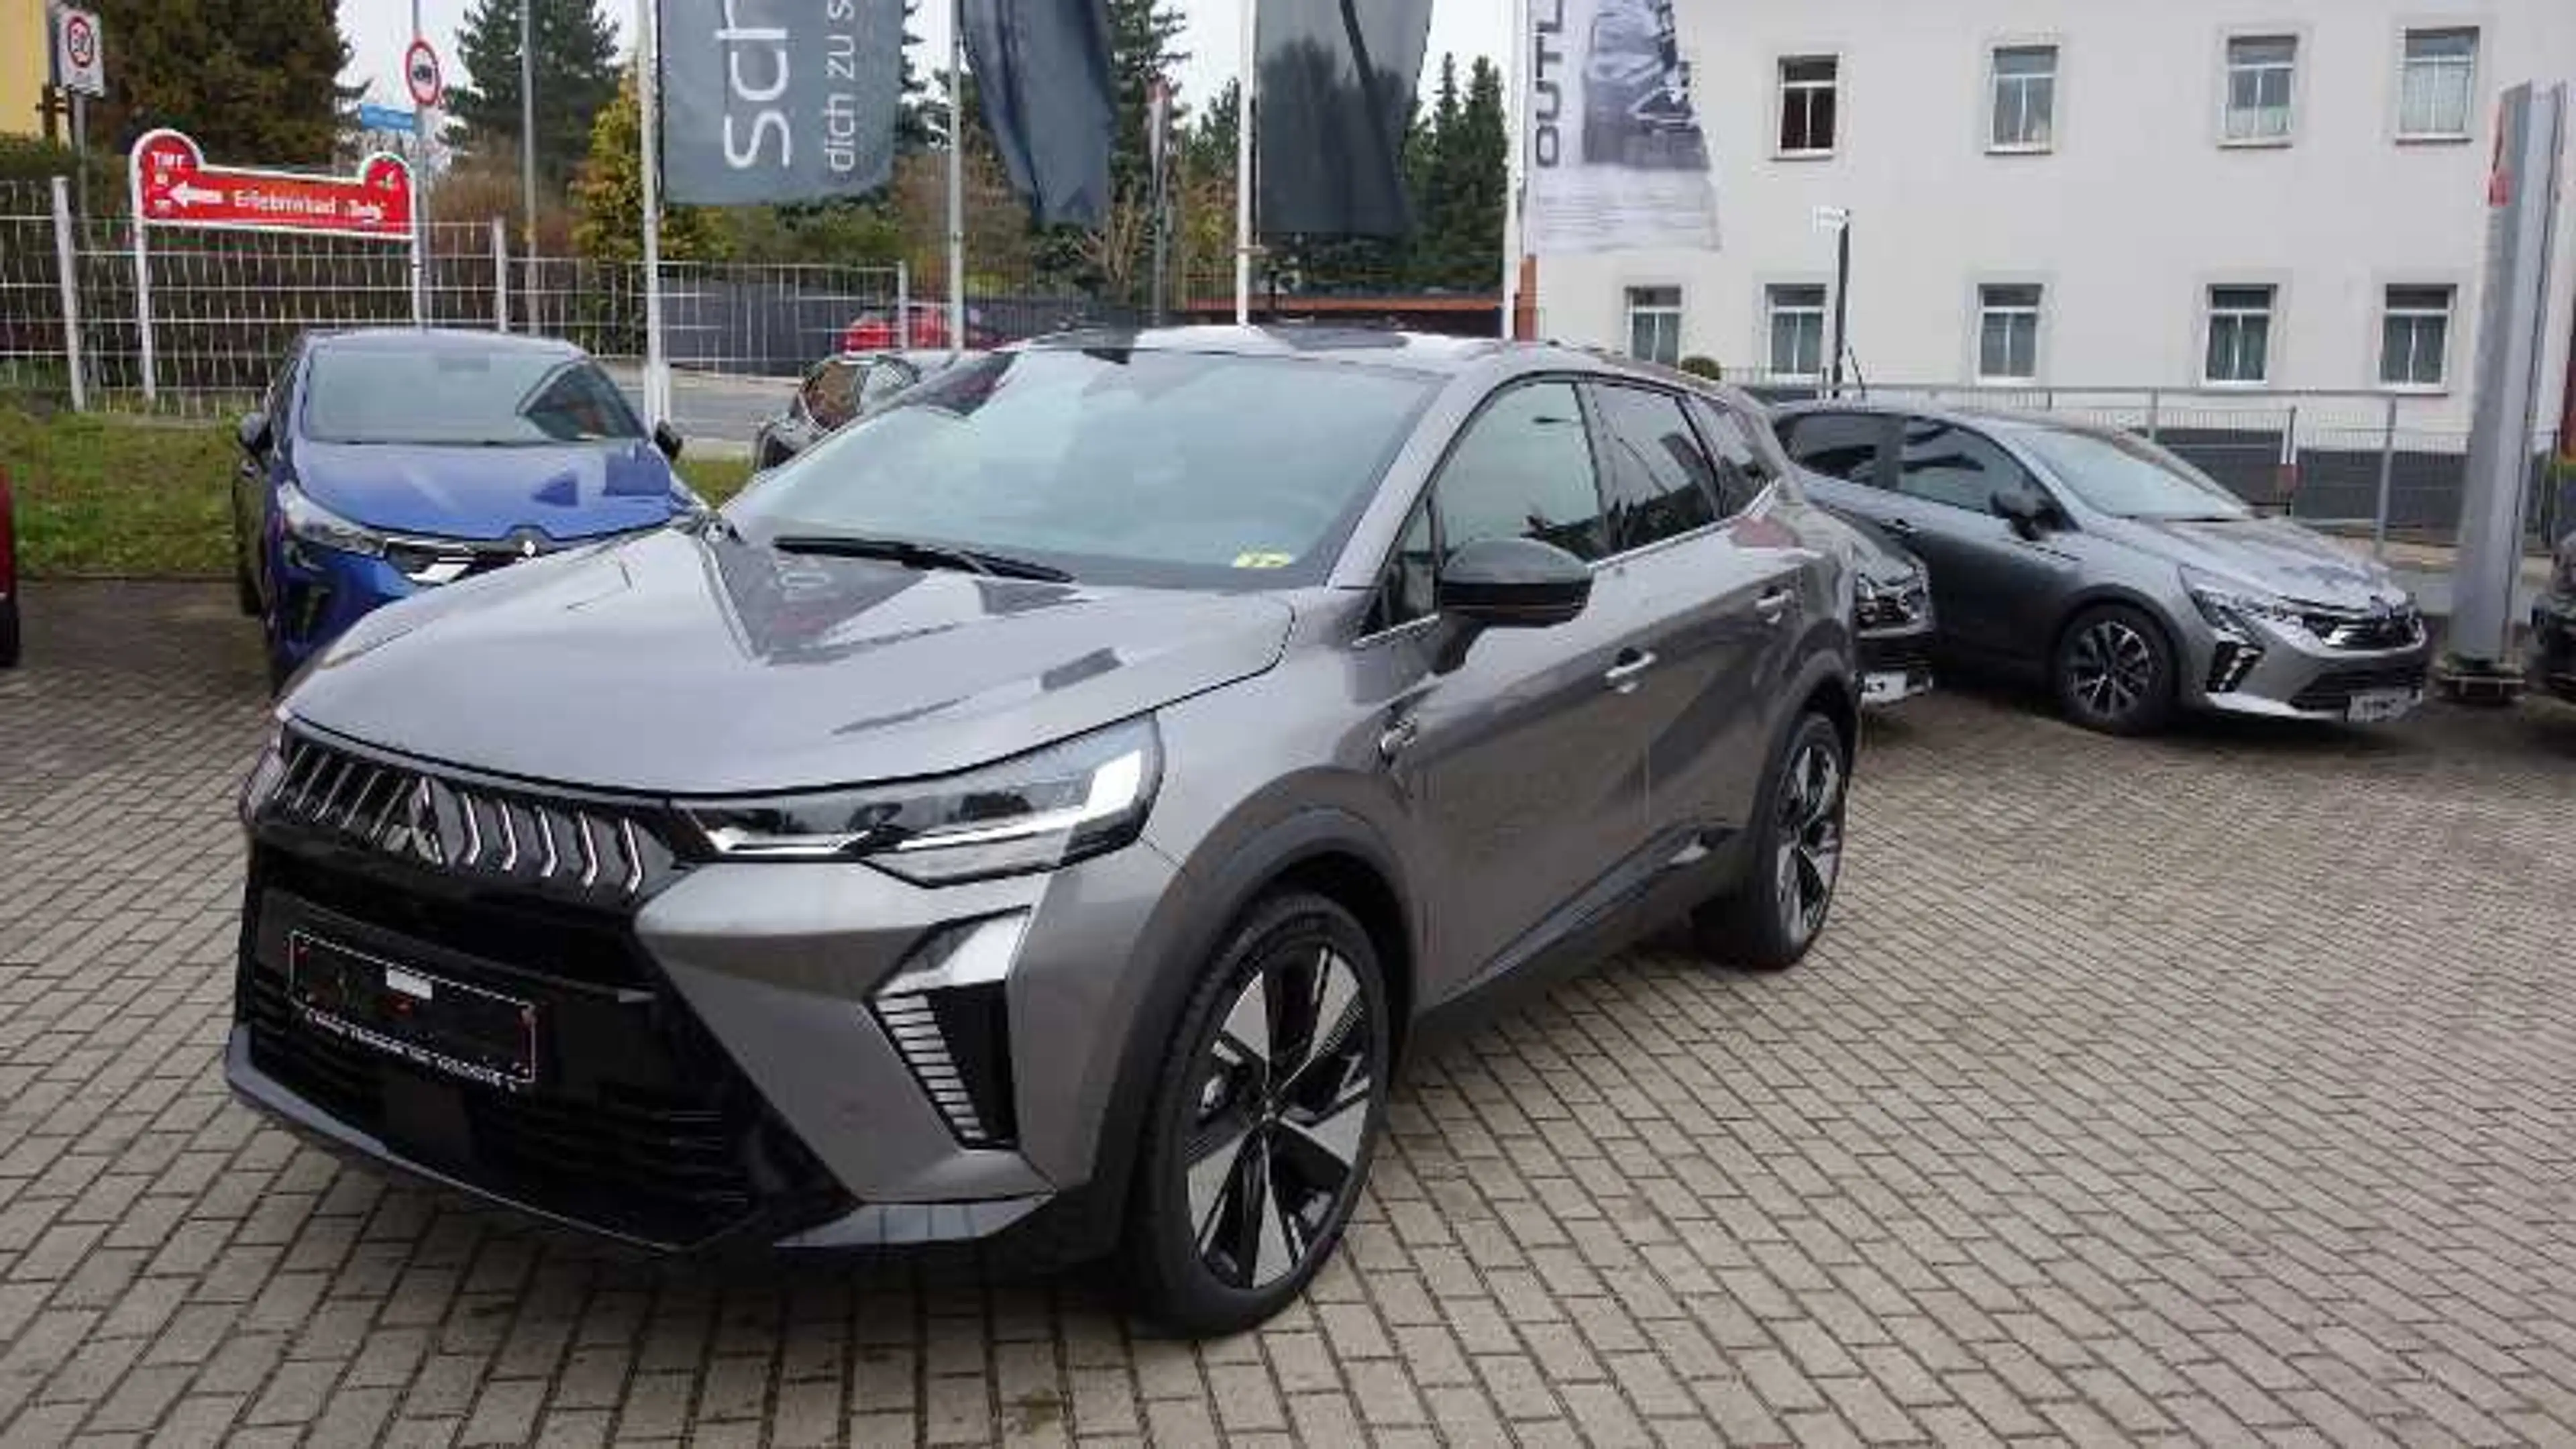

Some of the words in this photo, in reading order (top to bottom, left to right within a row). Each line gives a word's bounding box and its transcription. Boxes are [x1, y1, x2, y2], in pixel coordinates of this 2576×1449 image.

[824, 35, 855, 79] zu
[1536, 0, 1562, 168] OUTL
[824, 93, 855, 172] dich
